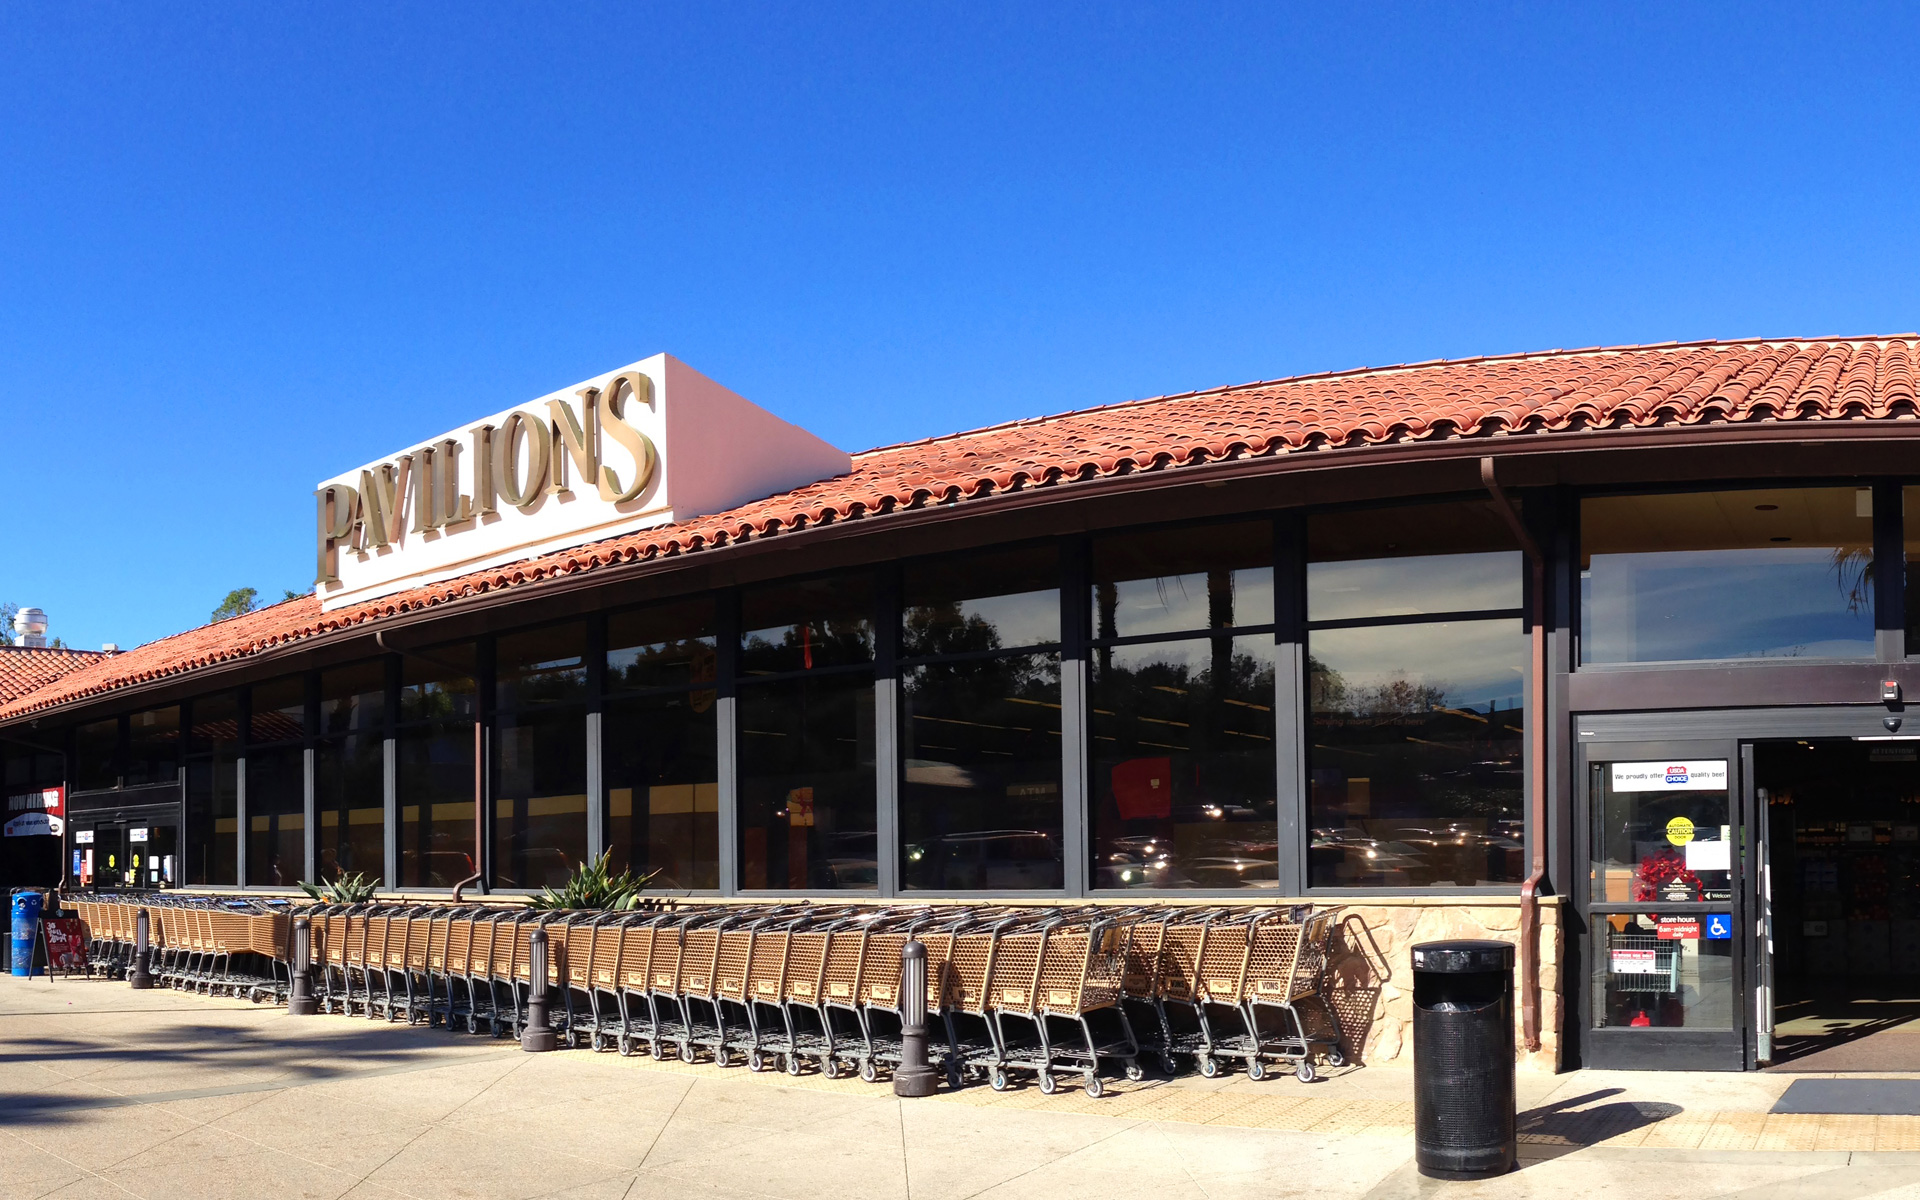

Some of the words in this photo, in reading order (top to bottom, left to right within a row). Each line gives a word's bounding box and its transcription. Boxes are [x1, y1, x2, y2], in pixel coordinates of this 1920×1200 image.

[313, 371, 656, 586] PAVILIONS
[1625, 773, 1648, 781] proudly
[1666, 775, 1688, 783] CHOICE
[1019, 787, 1046, 796] ATM
[9, 795, 26, 811] NOW
[1170, 979, 1185, 988] VONS
[1261, 981, 1279, 990] VONS
[958, 989, 975, 999] VONS
